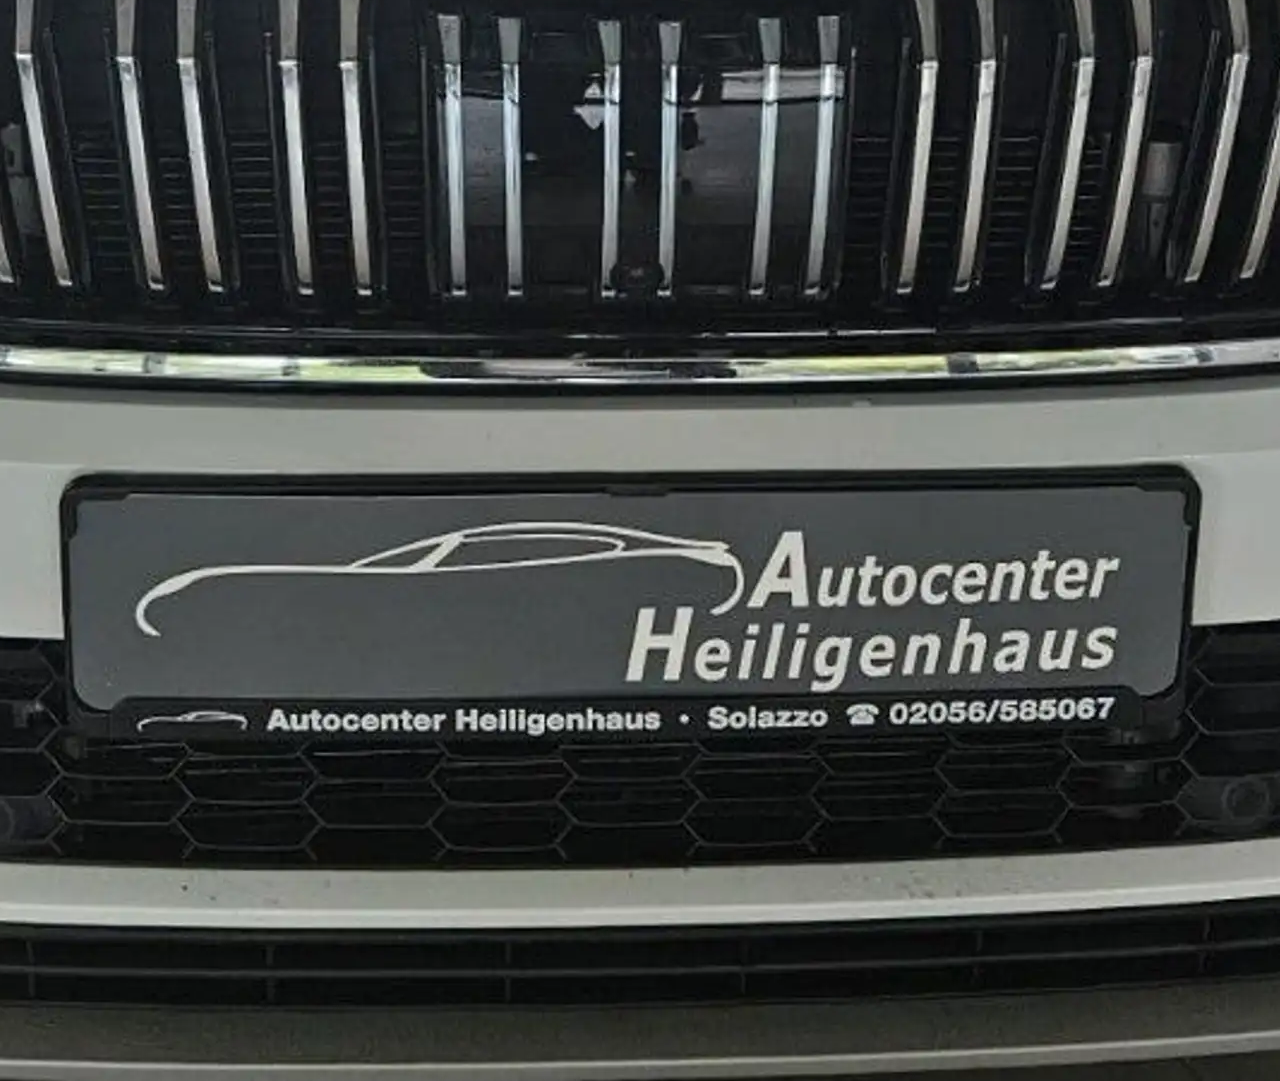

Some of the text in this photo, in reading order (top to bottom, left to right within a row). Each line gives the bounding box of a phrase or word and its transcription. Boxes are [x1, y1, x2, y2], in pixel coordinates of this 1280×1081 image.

[747, 531, 1120, 609] Autocenter
[626, 607, 1118, 692] Heiligenhaus
[267, 697, 1116, 736] Autocenter Heiligenhaus Solazzo 02056/585067
